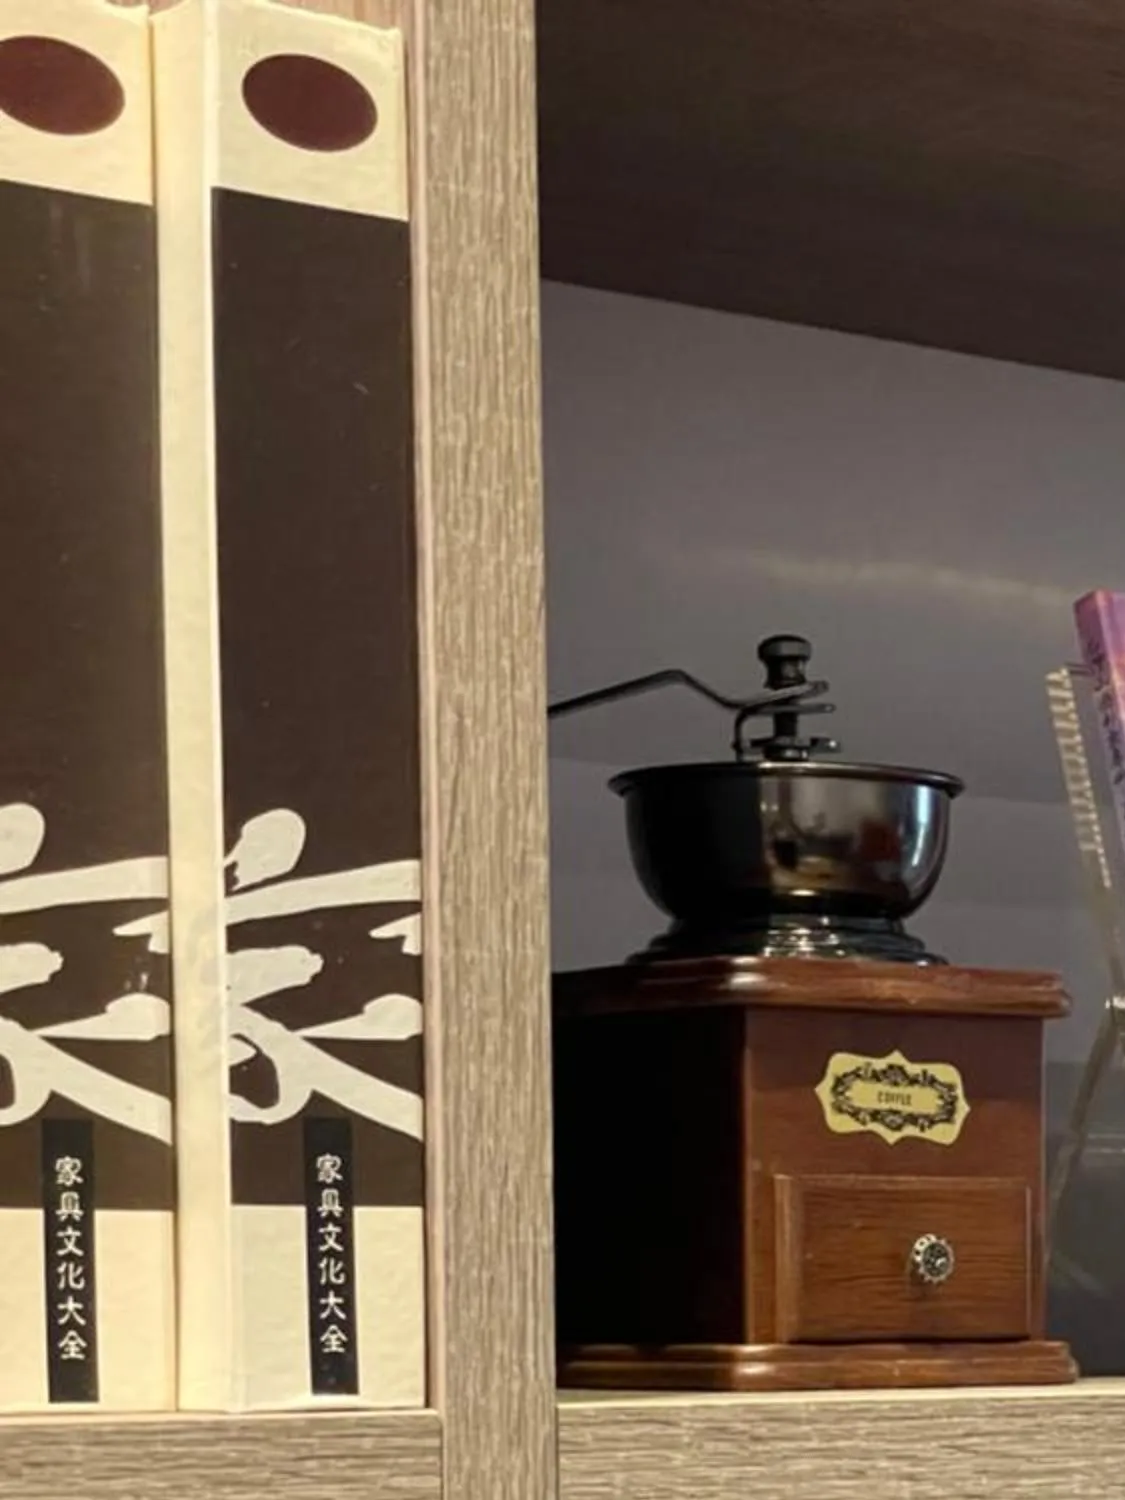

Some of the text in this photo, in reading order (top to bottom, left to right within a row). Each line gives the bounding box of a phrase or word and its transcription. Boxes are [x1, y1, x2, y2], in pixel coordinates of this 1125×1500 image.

[54, 1155, 88, 1361] 家具文化大全
[315, 1152, 349, 1355] 家具文化大全
